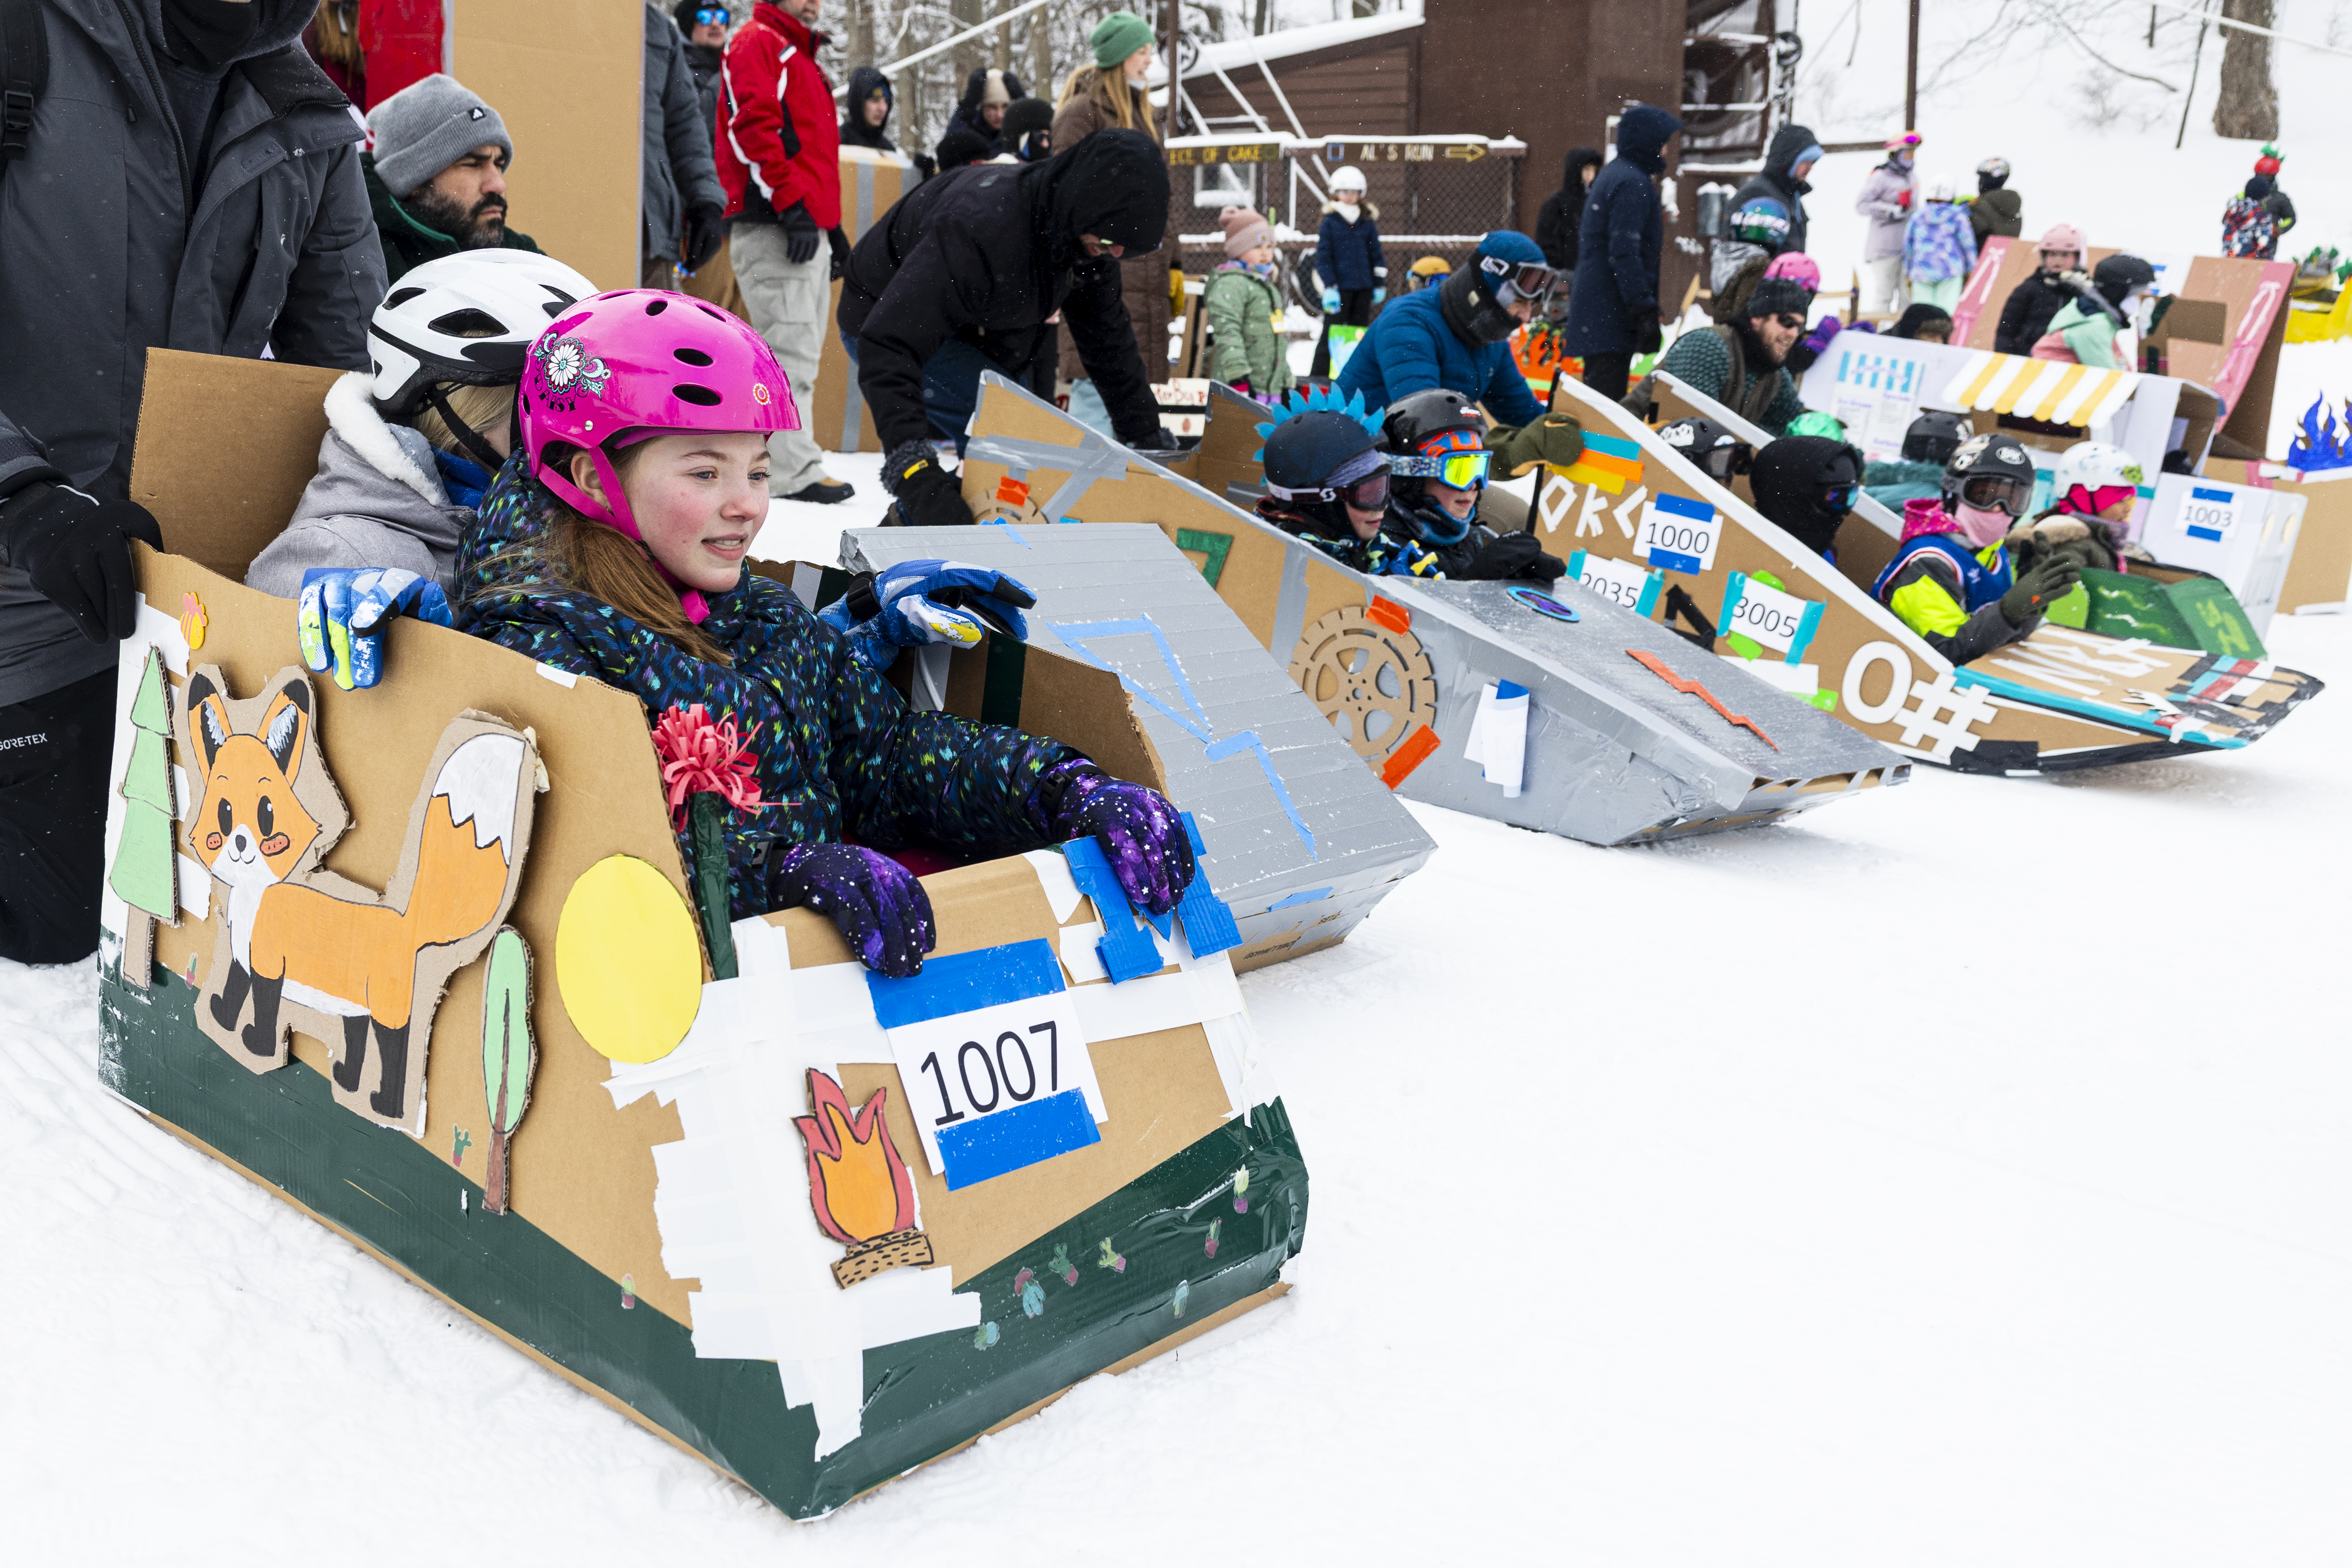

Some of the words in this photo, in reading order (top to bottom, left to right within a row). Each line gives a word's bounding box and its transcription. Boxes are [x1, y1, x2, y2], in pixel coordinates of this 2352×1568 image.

[534, 372, 577, 412] DAISY
[2184, 505, 2233, 528] 1003
[1645, 522, 1709, 554] 1000
[1733, 596, 1798, 637] 3005
[921, 1020, 1058, 1126] 1007
